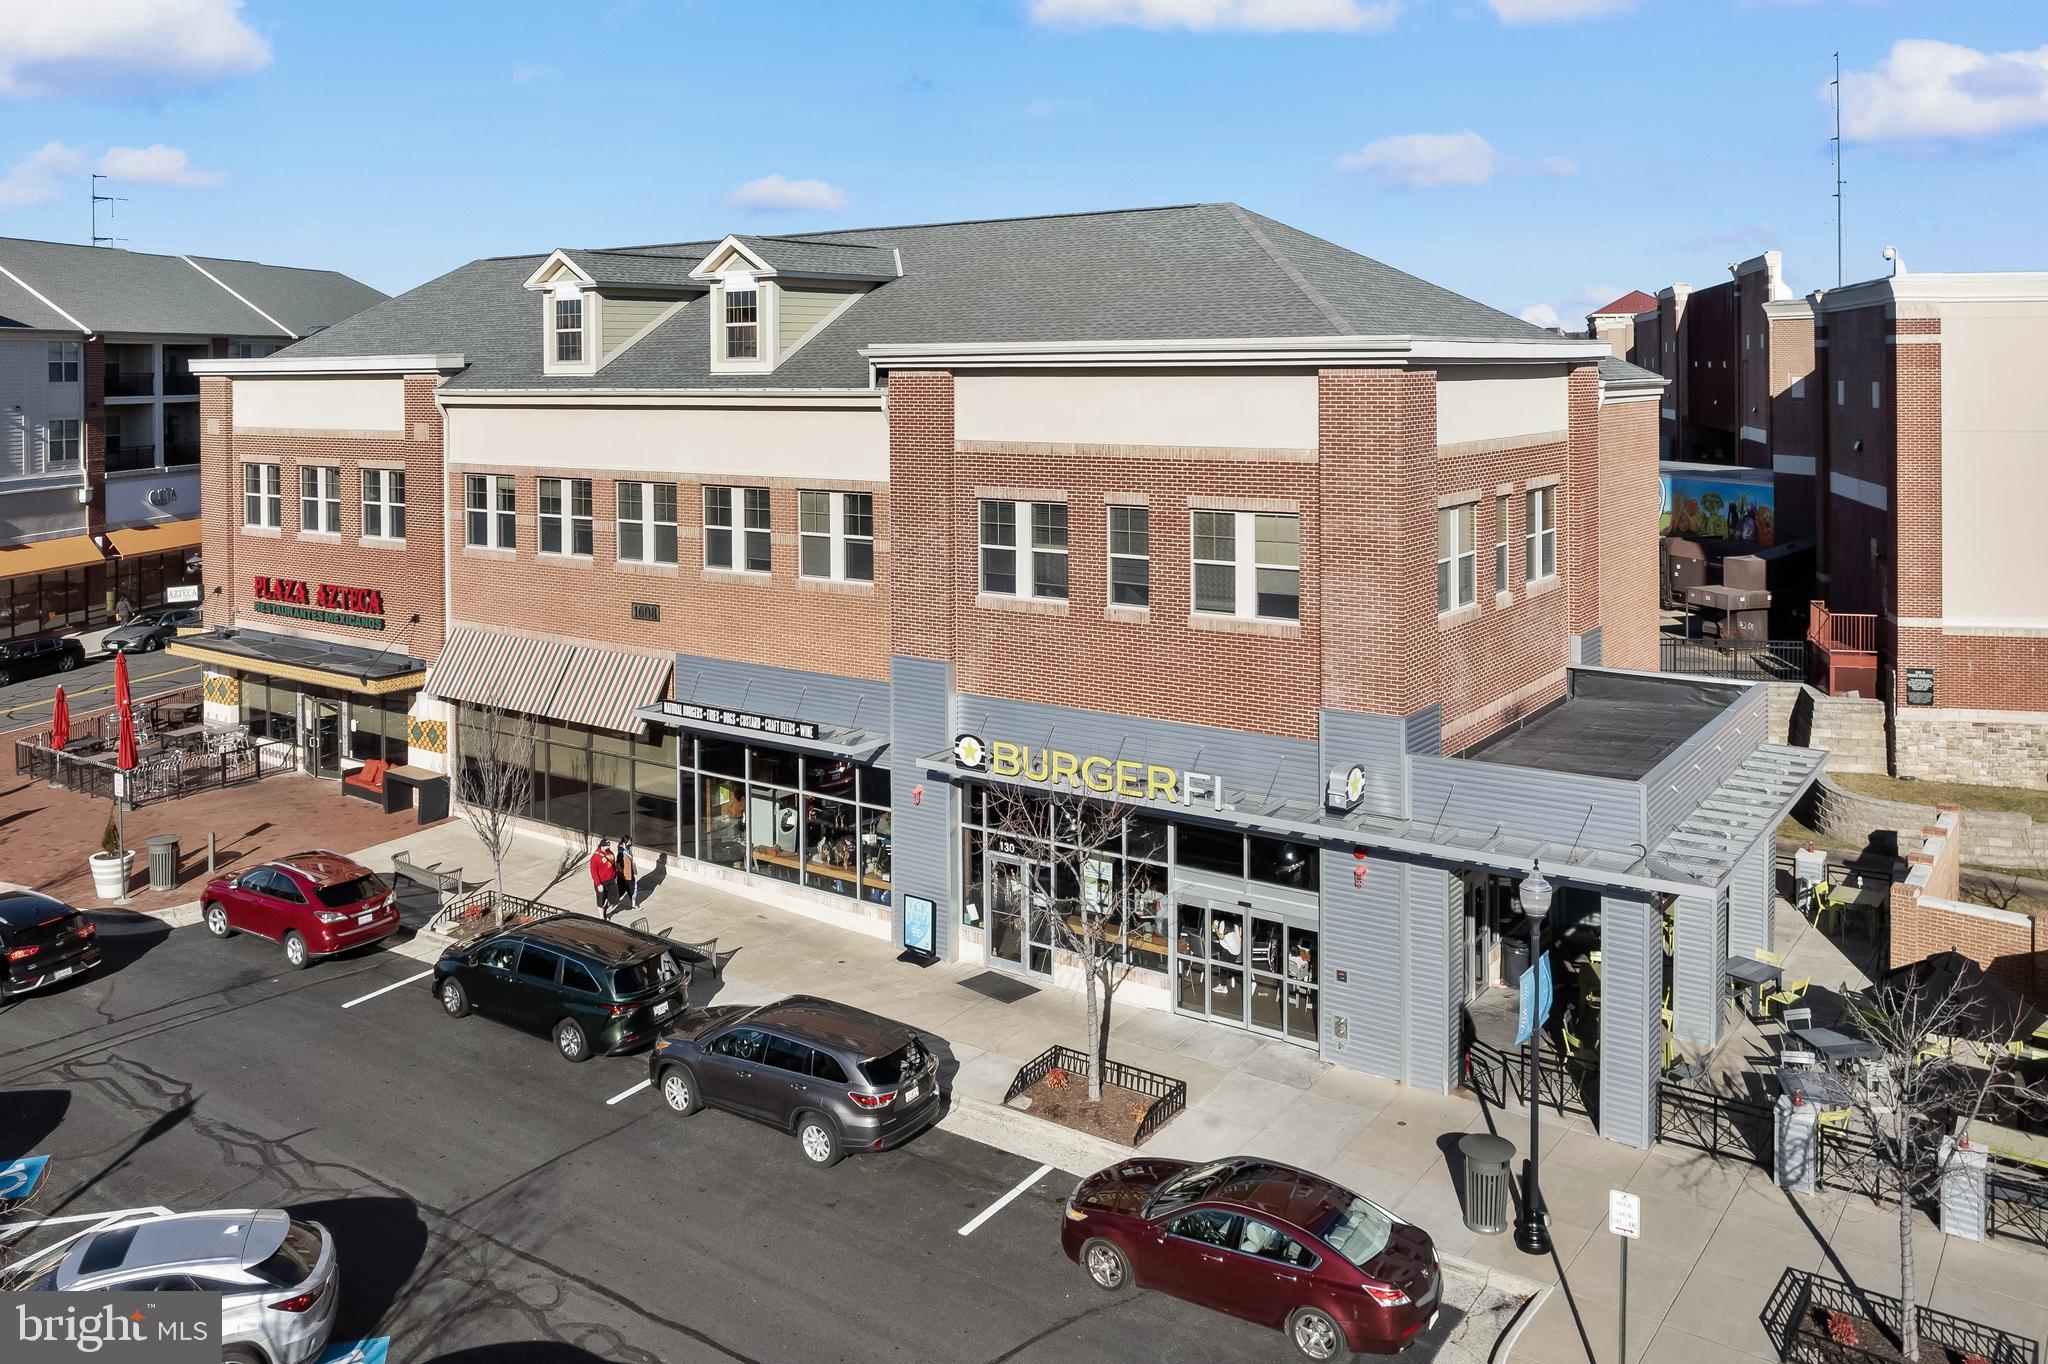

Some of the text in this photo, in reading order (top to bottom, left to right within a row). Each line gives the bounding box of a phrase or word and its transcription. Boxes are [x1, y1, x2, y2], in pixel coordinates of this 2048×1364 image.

[168, 587, 197, 600] AZTECA
[255, 576, 382, 615] PLAZA AZTECA
[634, 604, 658, 619] 1608
[324, 612, 382, 630] MEXICANOS
[663, 701, 814, 739] NATURAL BURGERS FRIES DOGS CUSTARD CRAFT BEERS WINE
[1000, 841, 1015, 853] 130
